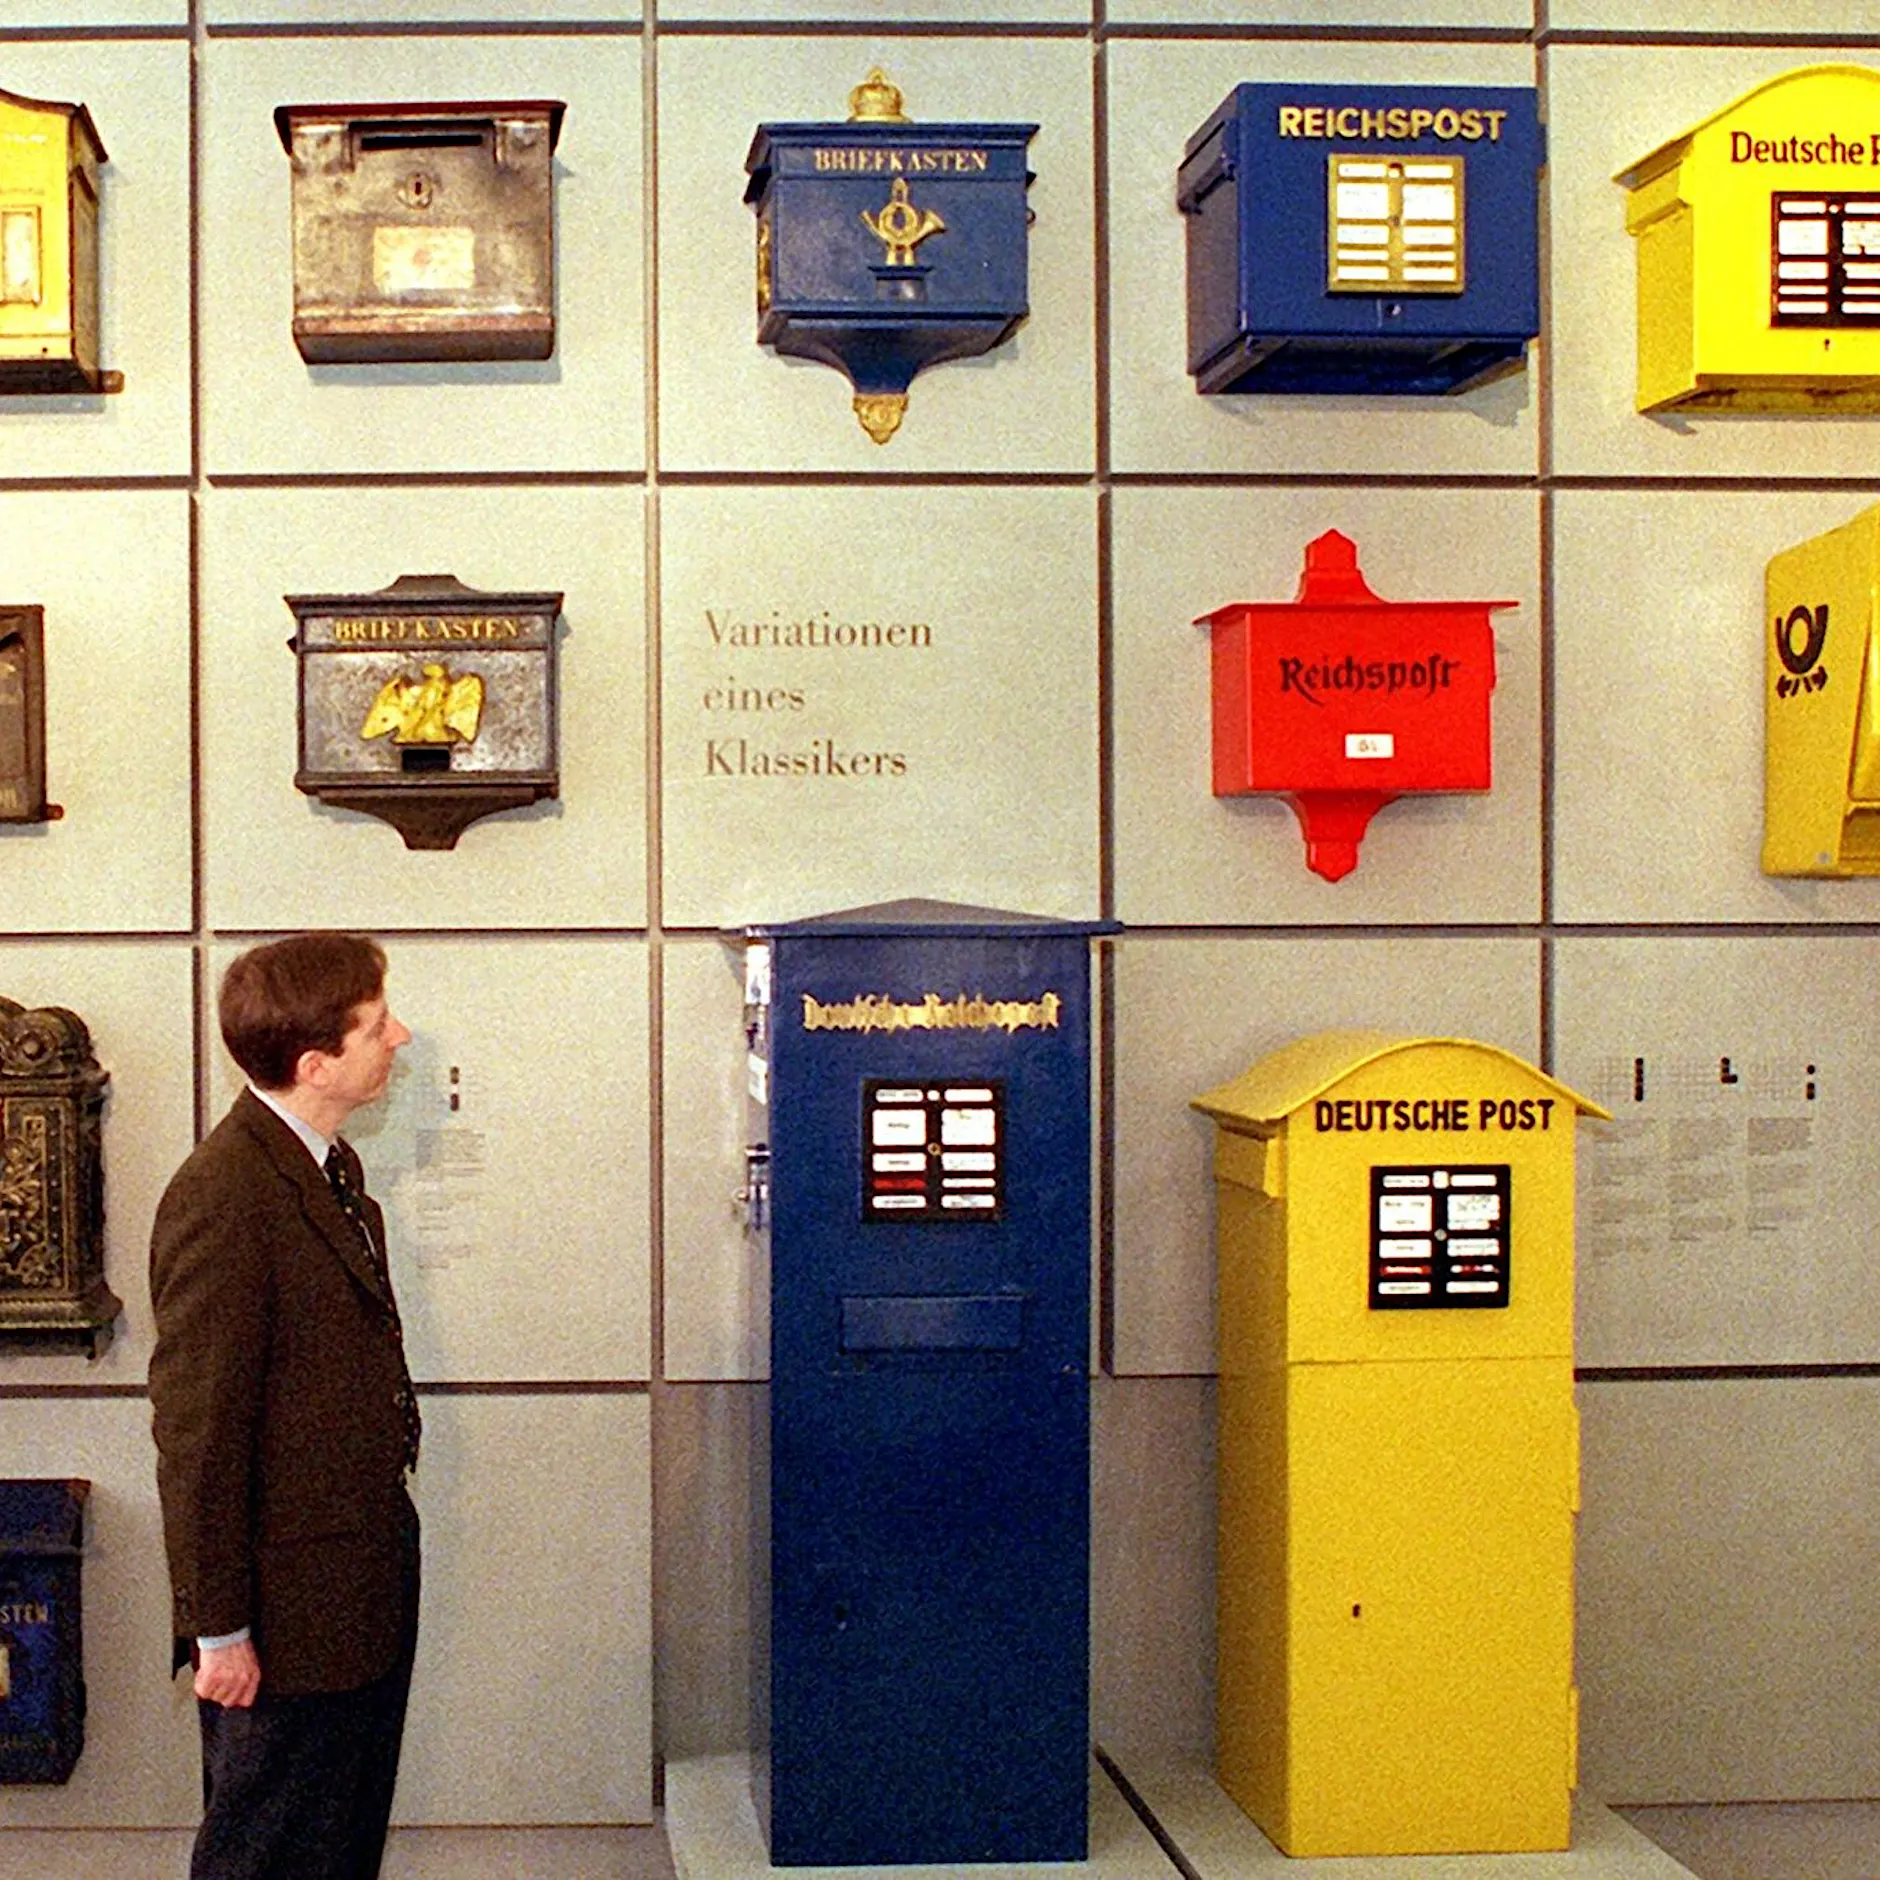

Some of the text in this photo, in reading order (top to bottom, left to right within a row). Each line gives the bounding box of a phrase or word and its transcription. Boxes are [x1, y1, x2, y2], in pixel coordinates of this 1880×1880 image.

[1278, 105, 1508, 141] REICHSPOST
[813, 149, 989, 173] BRIEFKASTEN
[1730, 131, 1865, 165] Deutsche
[334, 618, 521, 641] BRIEFKASTEN
[704, 609, 933, 648] Variationen
[703, 675, 805, 711] eines
[1279, 653, 1461, 708] Reichspost
[703, 738, 908, 776] Klassikers
[1315, 1098, 1555, 1132] DEUTSCHE POST
